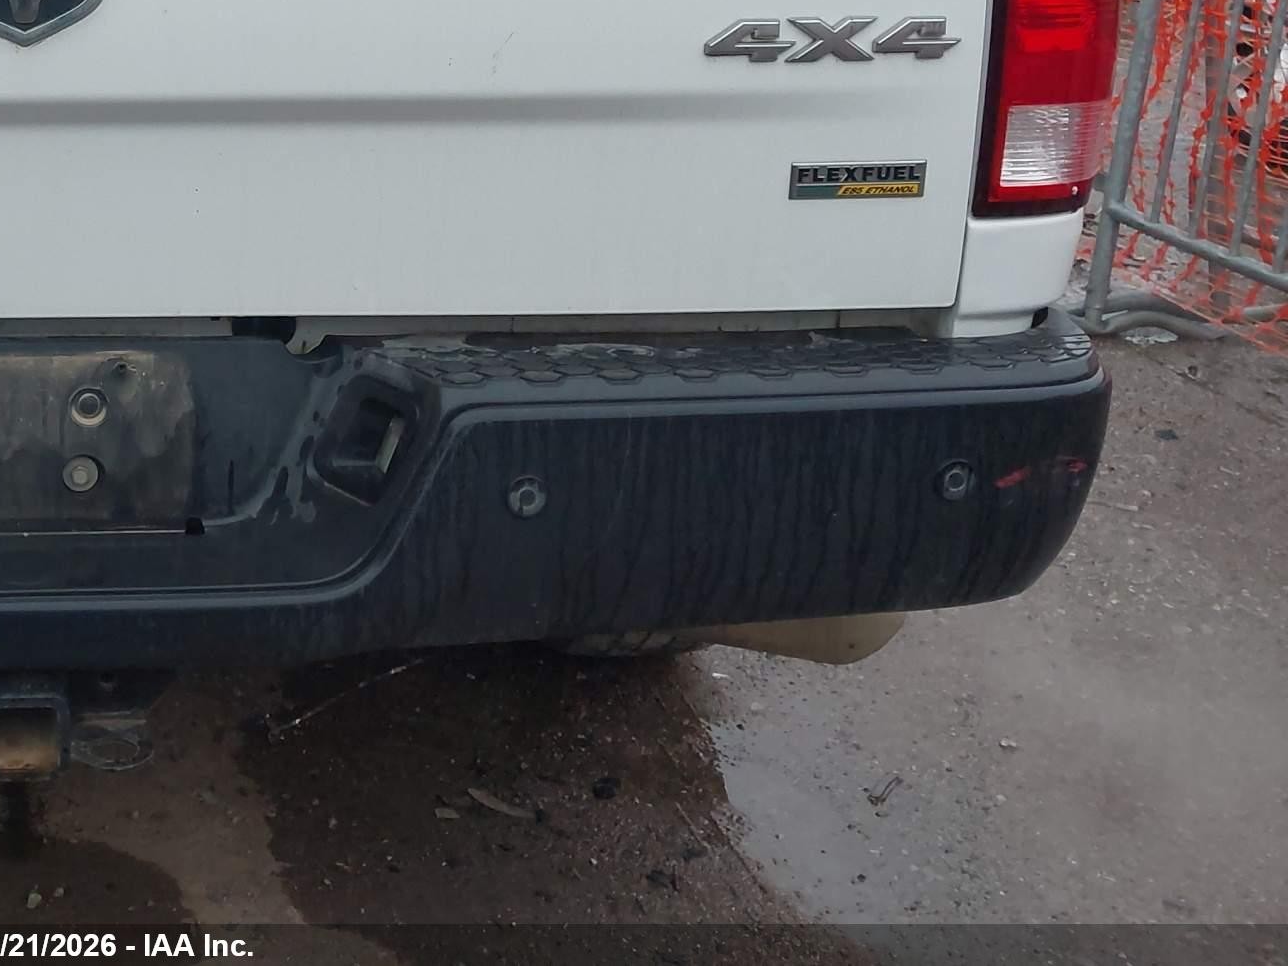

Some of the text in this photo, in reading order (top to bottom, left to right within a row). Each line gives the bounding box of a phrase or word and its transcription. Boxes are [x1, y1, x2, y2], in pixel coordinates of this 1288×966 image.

[704, 16, 962, 62] 4X4
[797, 165, 921, 184] FLEXFUEL
[842, 185, 915, 195] E85 ETHANOL
